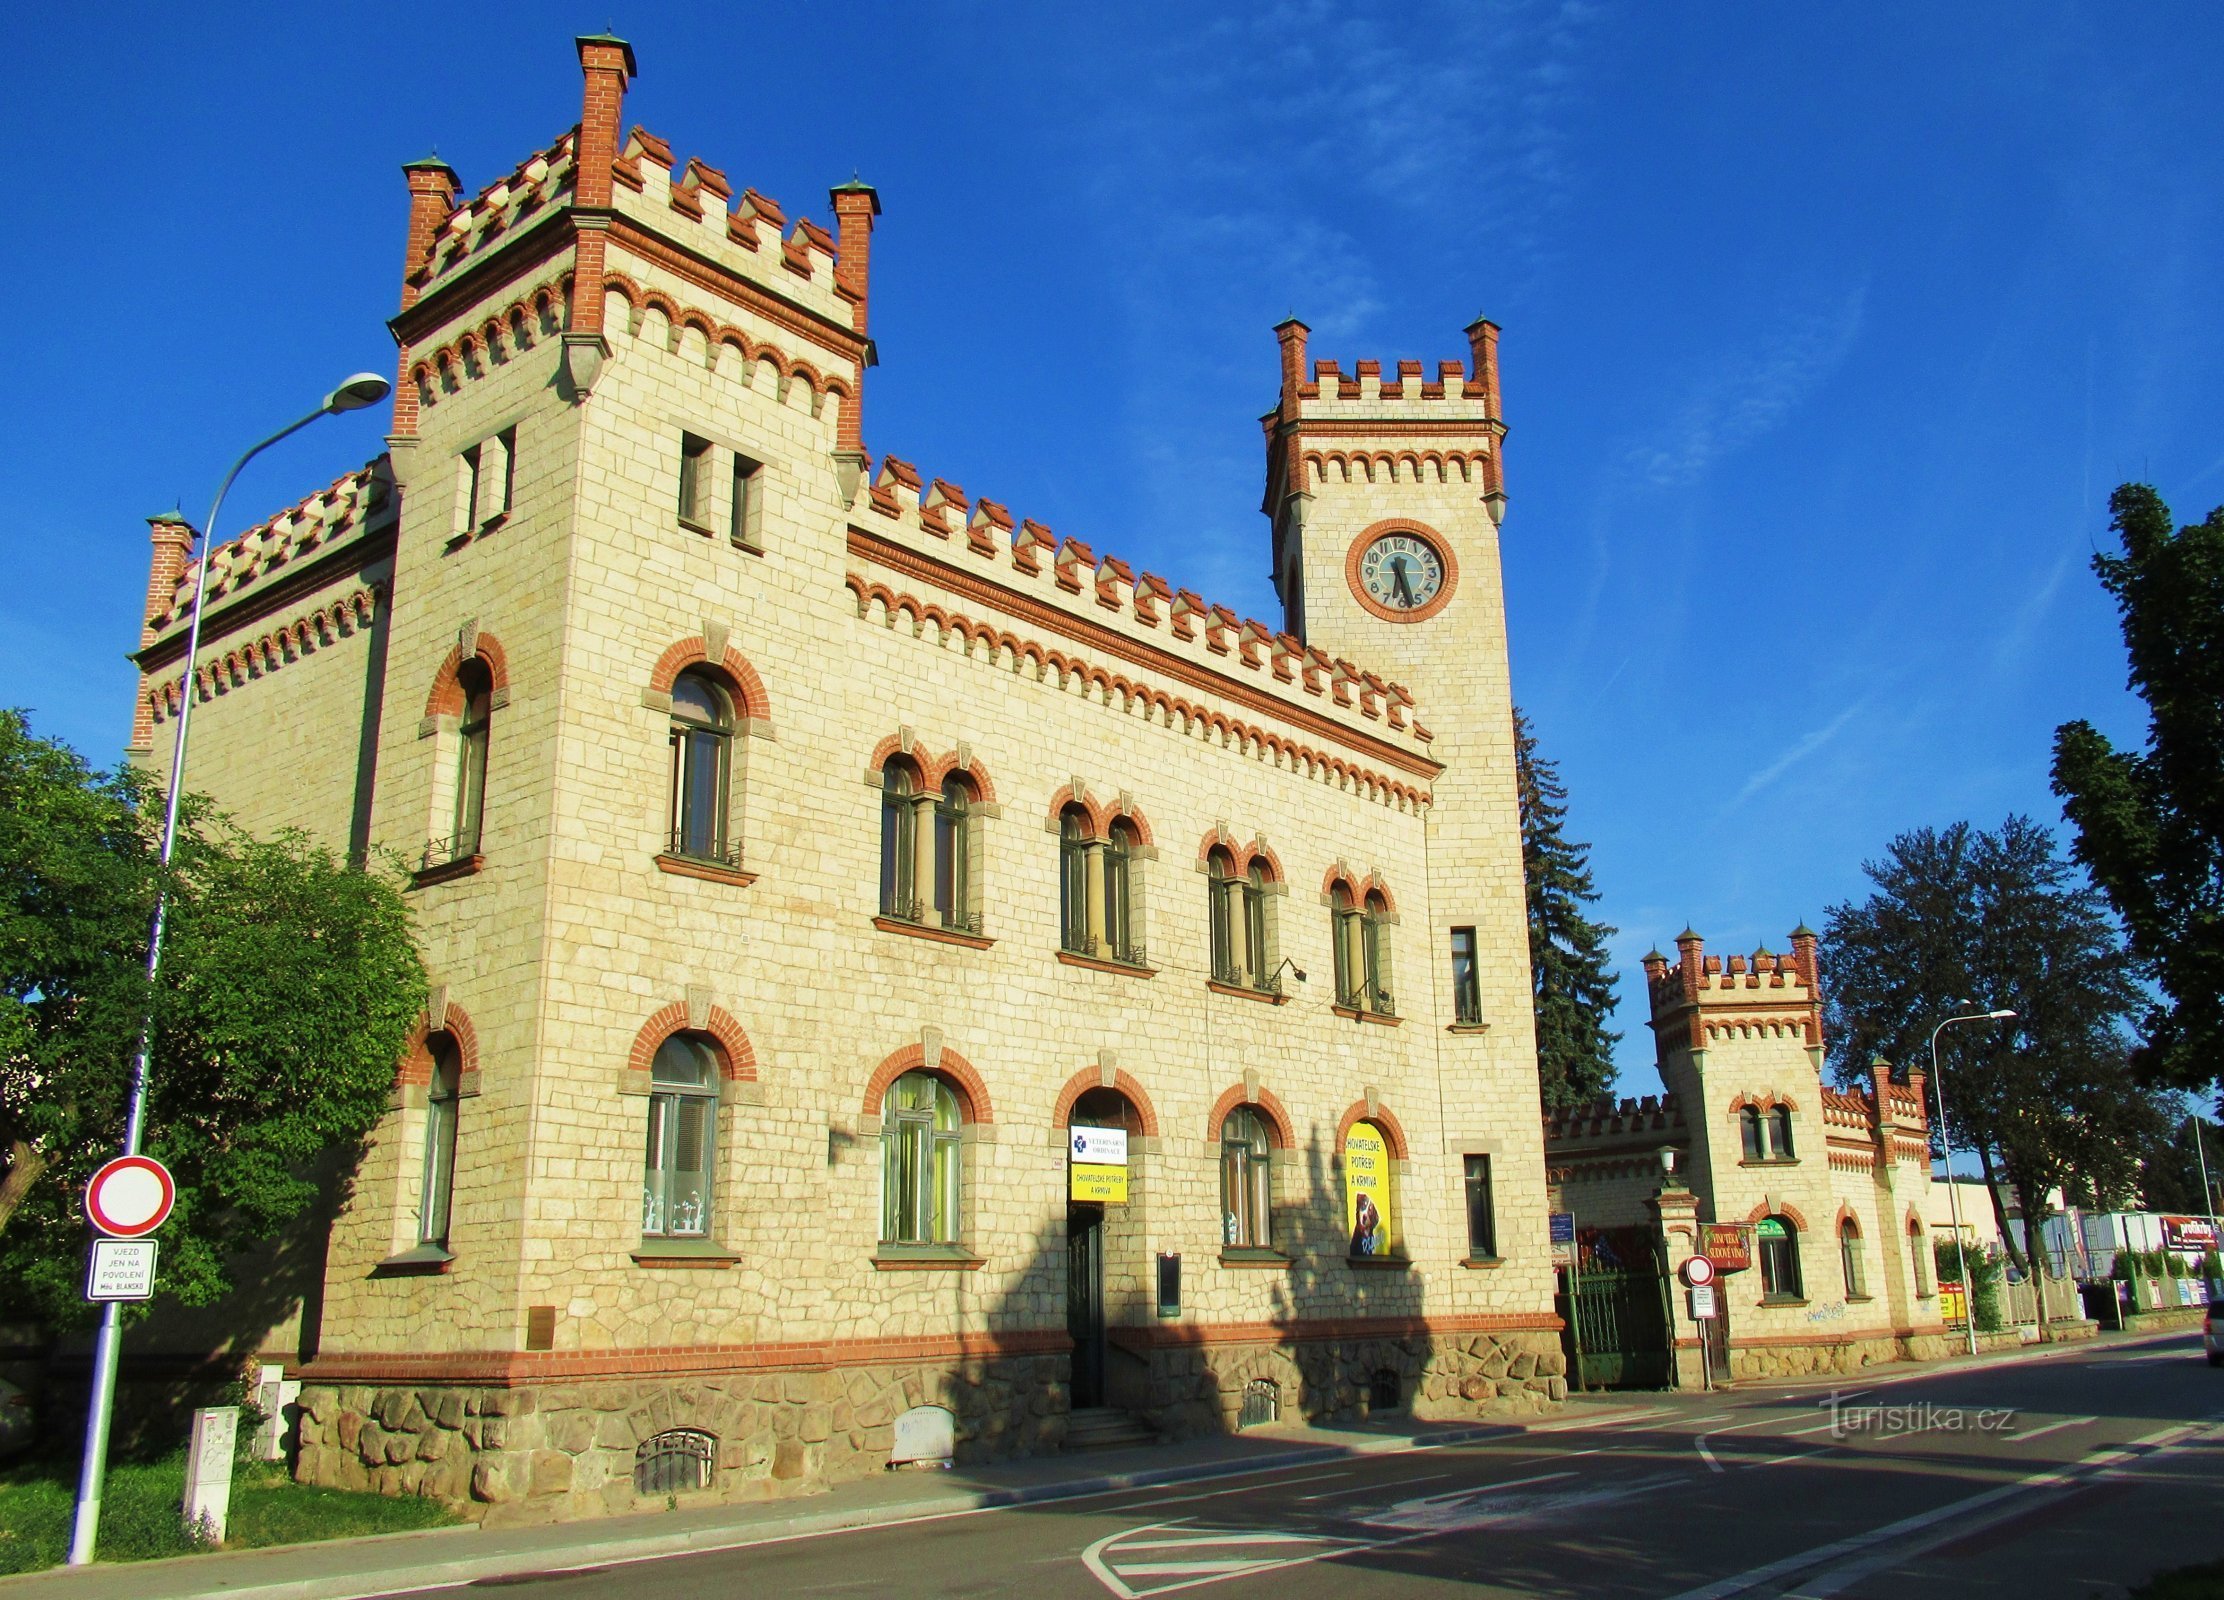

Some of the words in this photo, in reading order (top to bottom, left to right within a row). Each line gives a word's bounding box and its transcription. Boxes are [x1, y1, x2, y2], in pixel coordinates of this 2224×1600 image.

[1379, 541, 1389, 552] 11
[1393, 538, 1406, 550] 12
[1412, 542, 1419, 553] 1
[1367, 552, 1379, 562] 10
[1424, 552, 1434, 564] 2
[1365, 567, 1375, 578] 9
[1427, 567, 1438, 579] 3
[1370, 582, 1380, 594] 8
[1424, 581, 1434, 594] 4
[1383, 592, 1391, 604] 7
[1398, 595, 1407, 608] 6
[1413, 593, 1423, 605] 5
[1092, 1146, 1120, 1155] ORDINACE
[1351, 1154, 1375, 1169] POTŘEBY
[1351, 1175, 1356, 1186] A
[1357, 1175, 1377, 1189] KRMIVA
[1090, 1186, 1094, 1194] A
[113, 1248, 140, 1256] VJEZD
[108, 1259, 126, 1268] JEN
[128, 1259, 141, 1268] NA
[103, 1269, 145, 1279] POVOLENÍ
[116, 1282, 144, 1290] BLANSKO
